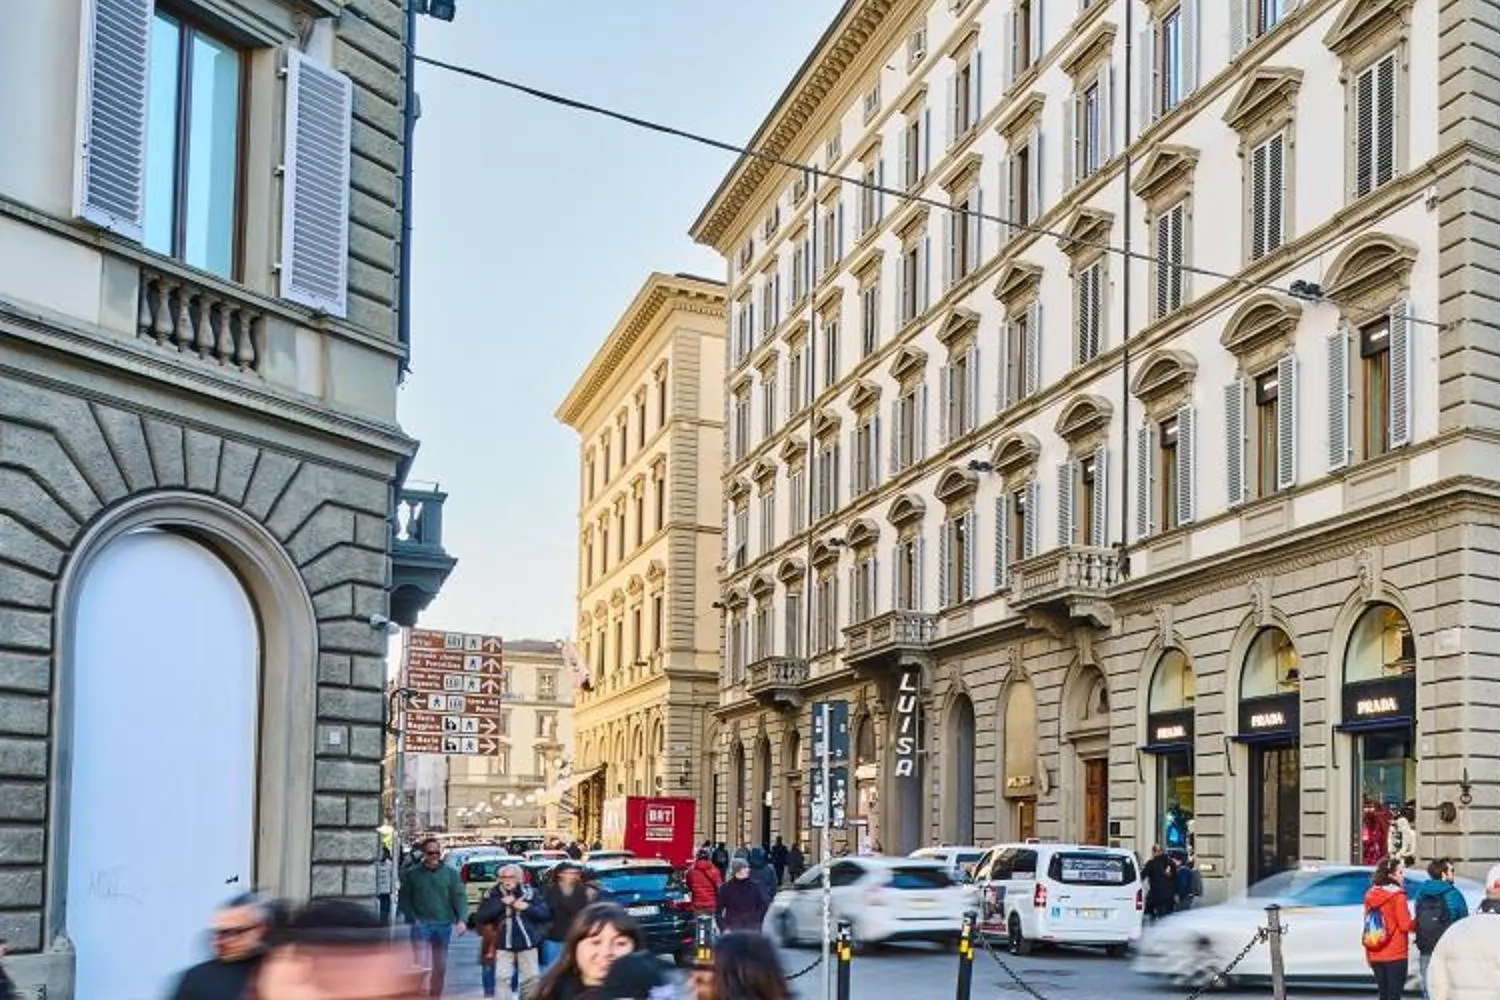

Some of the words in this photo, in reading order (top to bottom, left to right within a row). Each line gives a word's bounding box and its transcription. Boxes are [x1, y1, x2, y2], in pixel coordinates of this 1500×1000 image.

[1357, 697, 1398, 715] PRADA
[895, 673, 917, 777] LUISA
[649, 809, 672, 823] BRT
